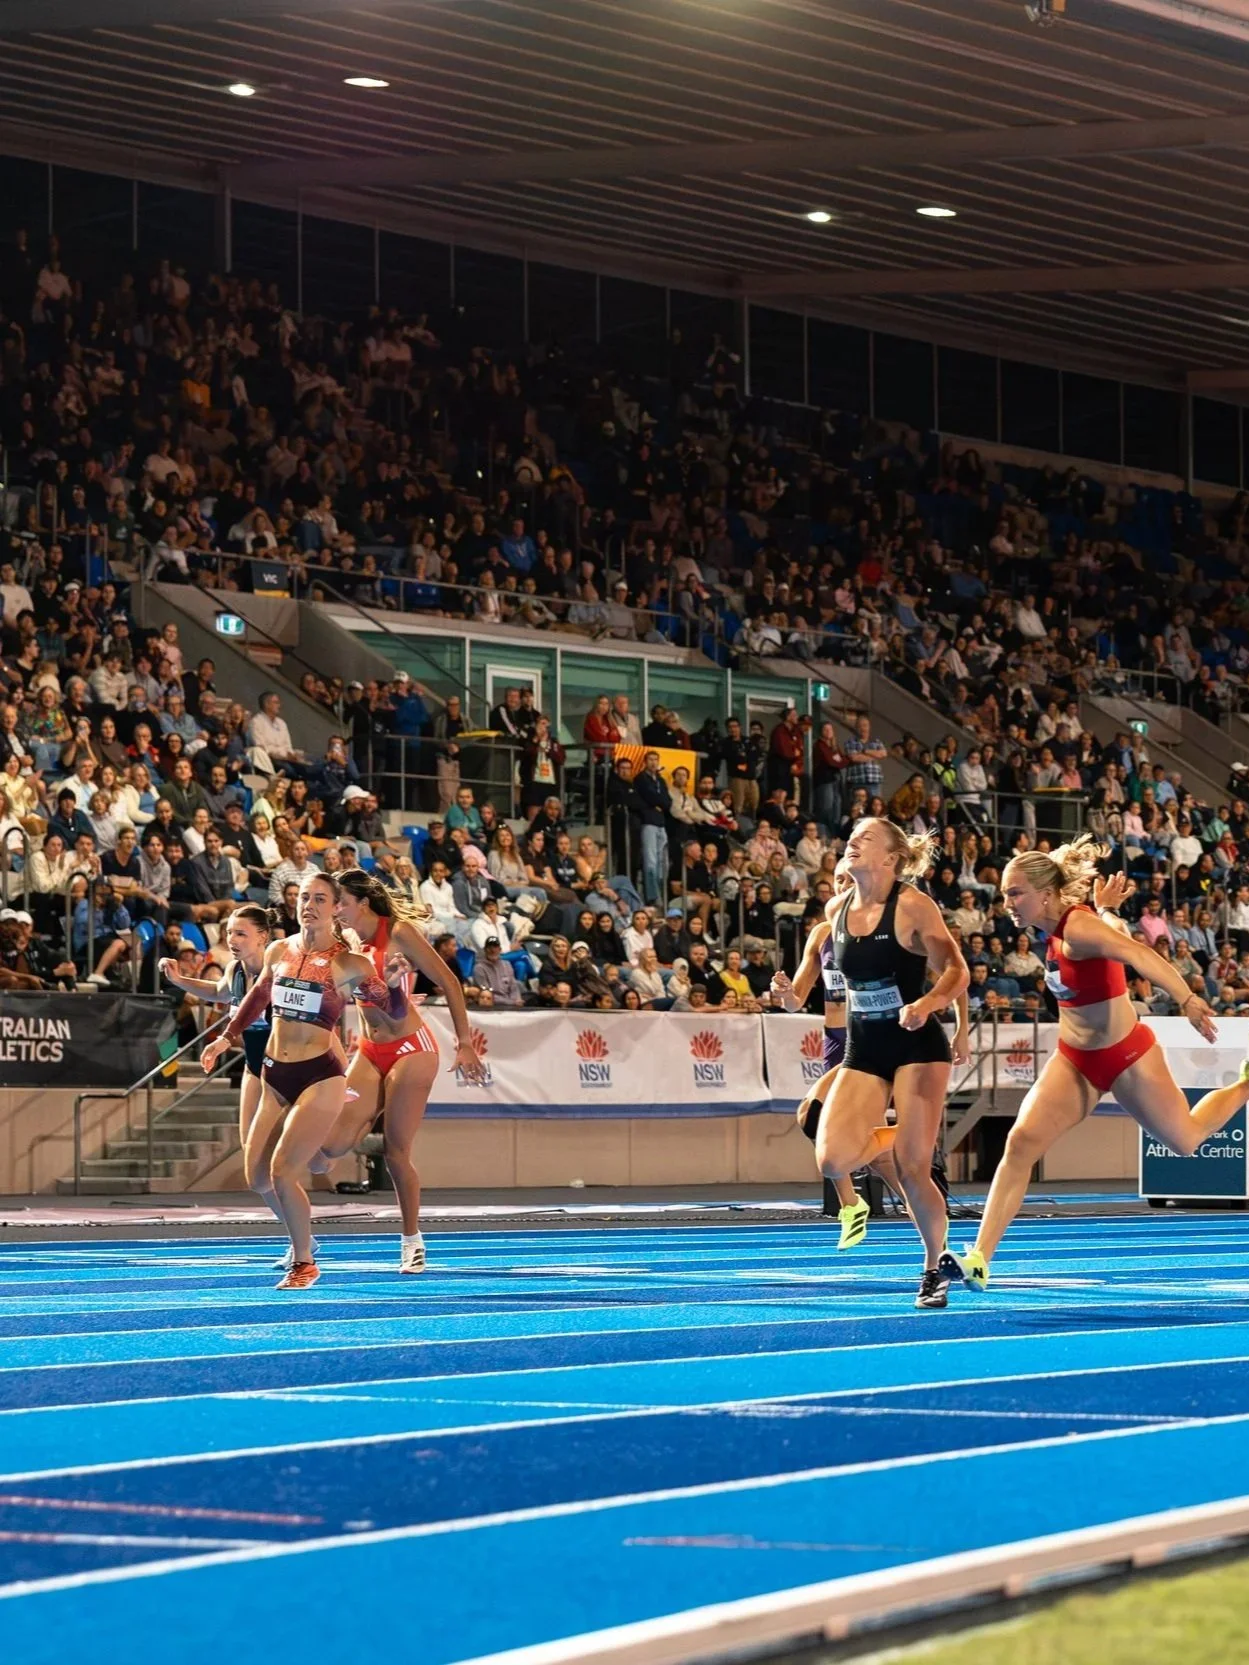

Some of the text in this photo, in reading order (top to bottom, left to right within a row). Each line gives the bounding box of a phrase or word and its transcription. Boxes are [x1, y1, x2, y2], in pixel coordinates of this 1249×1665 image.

[284, 991, 306, 1006] LANE
[0, 1017, 71, 1040] RALIAN
[579, 1063, 610, 1081] NSW
[693, 1063, 724, 1081] NSW
[1200, 1144, 1243, 1158] Centre
